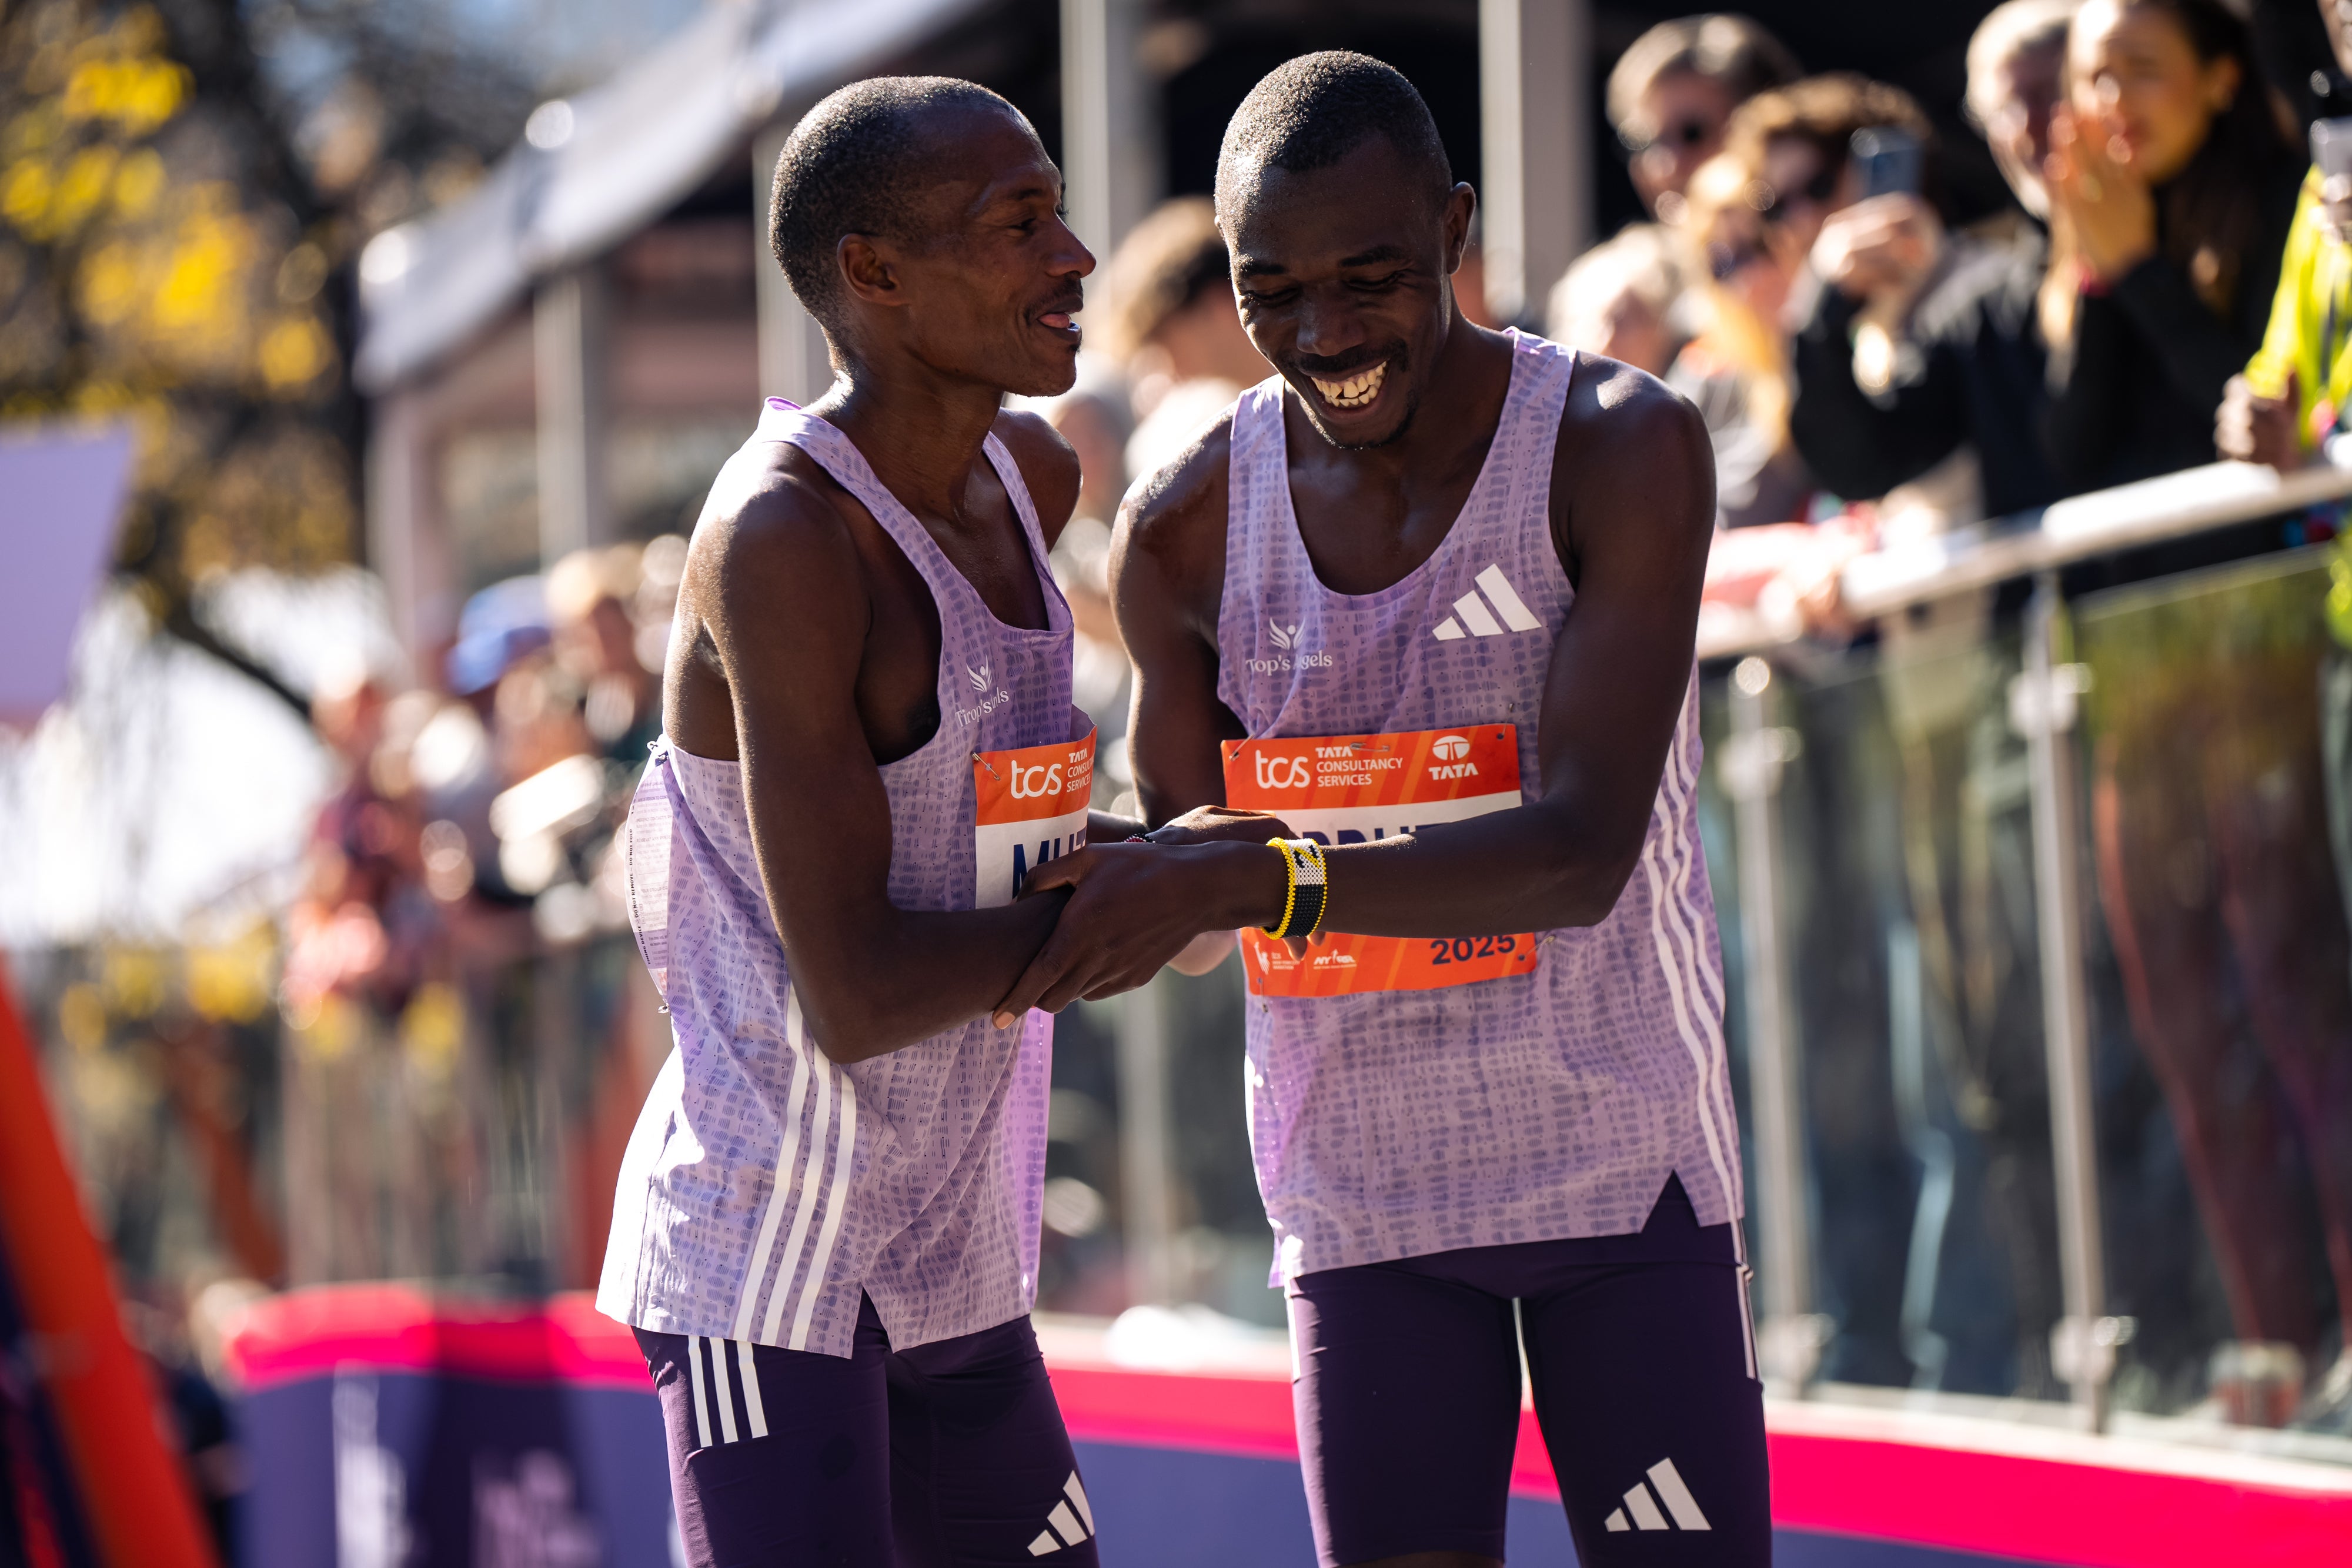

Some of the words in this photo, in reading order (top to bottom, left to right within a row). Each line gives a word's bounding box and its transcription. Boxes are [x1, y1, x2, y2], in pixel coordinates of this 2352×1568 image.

[955, 699, 993, 727] Tirop's
[1068, 748, 1087, 764] TATA
[1315, 746, 1353, 758] TATA
[1255, 749, 1311, 789] tcs
[1317, 757, 1403, 773] CONSULTANCY
[1428, 763, 1479, 780] TATA
[1011, 760, 1062, 799] tcs
[1067, 772, 1091, 793] SERVICES
[1317, 773, 1372, 787] SERVICES
[629, 857, 633, 865] DO
[634, 910, 639, 918] DO
[643, 945, 651, 964] TIMING
[1431, 935, 1515, 965] 2025
